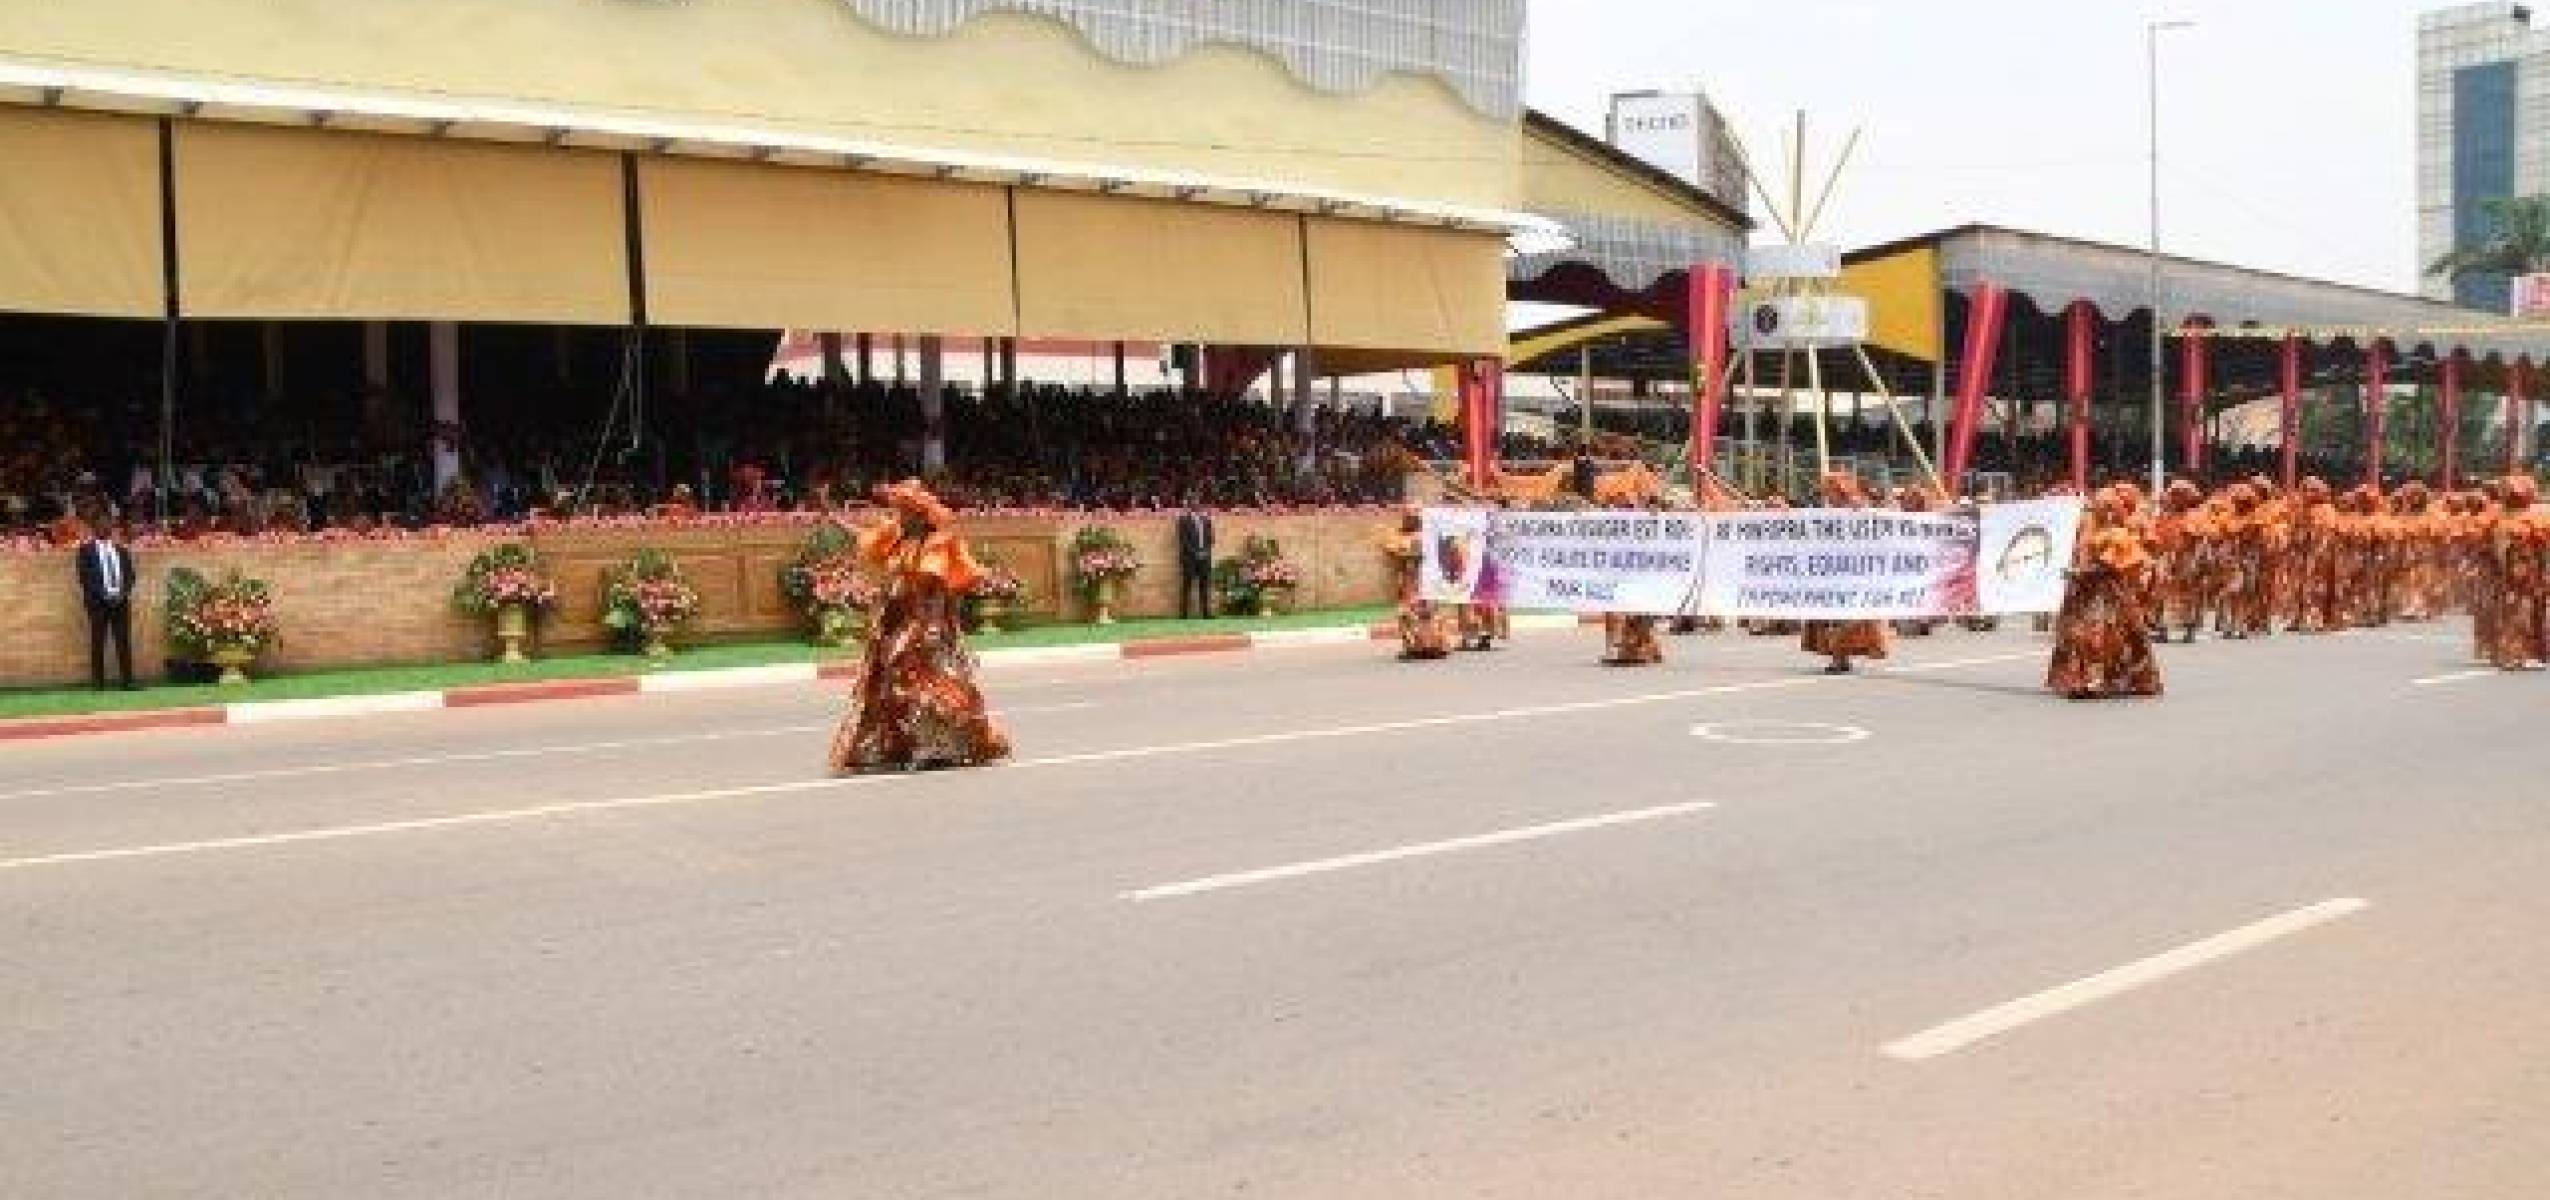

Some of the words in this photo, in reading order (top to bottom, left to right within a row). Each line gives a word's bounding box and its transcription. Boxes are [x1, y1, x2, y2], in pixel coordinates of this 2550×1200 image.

[1812, 519, 1843, 540] THE
[1848, 520, 1894, 540] USER
[1808, 555, 1885, 577] EQUALITY
[1892, 556, 1929, 577] AND
